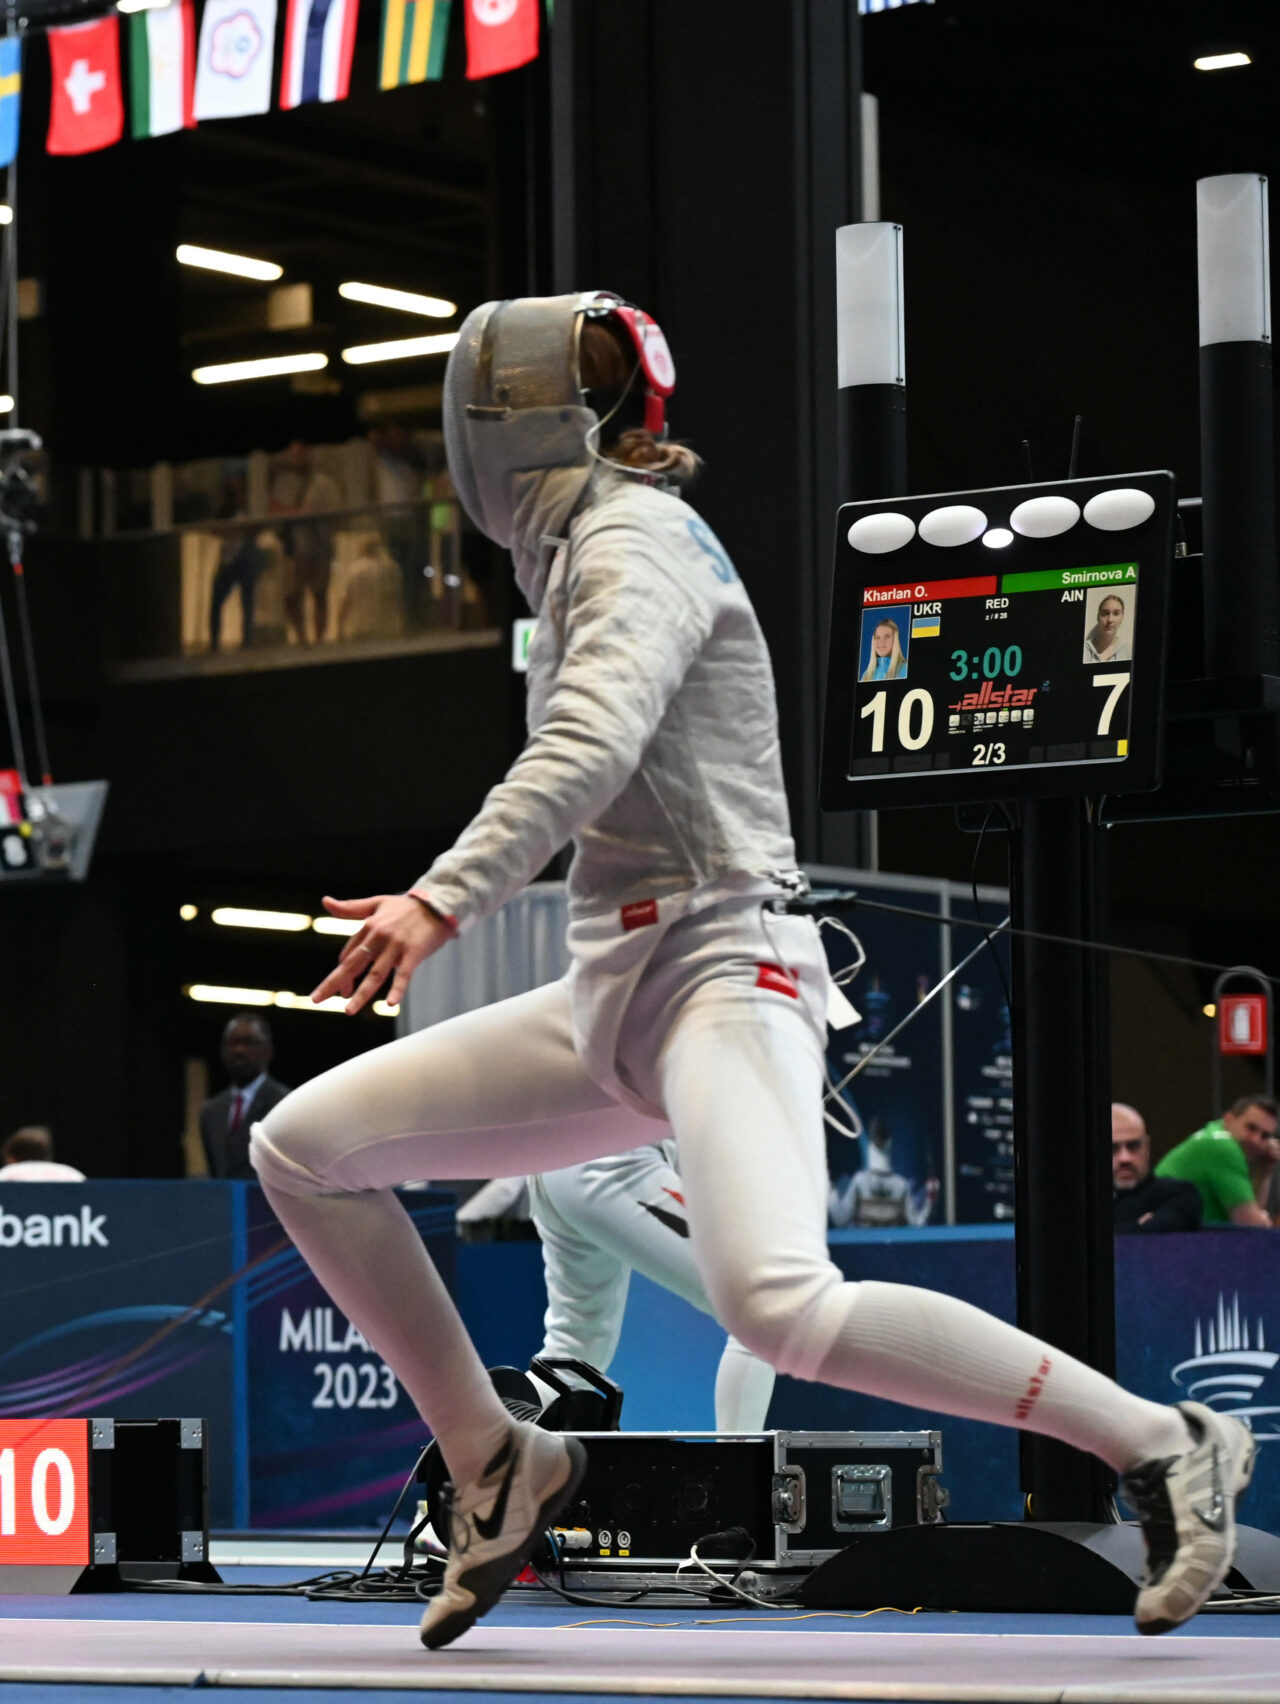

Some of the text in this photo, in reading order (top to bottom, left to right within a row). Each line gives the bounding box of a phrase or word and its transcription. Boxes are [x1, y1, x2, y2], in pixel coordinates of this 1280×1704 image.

[1062, 566, 1136, 585] Smirnova A
[863, 585, 928, 603] Kharlan O.
[985, 597, 1009, 610] RED
[1060, 589, 1084, 603] AIN
[913, 602, 942, 616] UKR
[949, 645, 1023, 681] 3:00
[961, 681, 1038, 710] allstar
[1092, 672, 1131, 736] 7
[860, 688, 935, 753] 10
[971, 742, 1007, 766] 2/3
[280, 1306, 376, 1352] MILA
[312, 1362, 399, 1409] 2023
